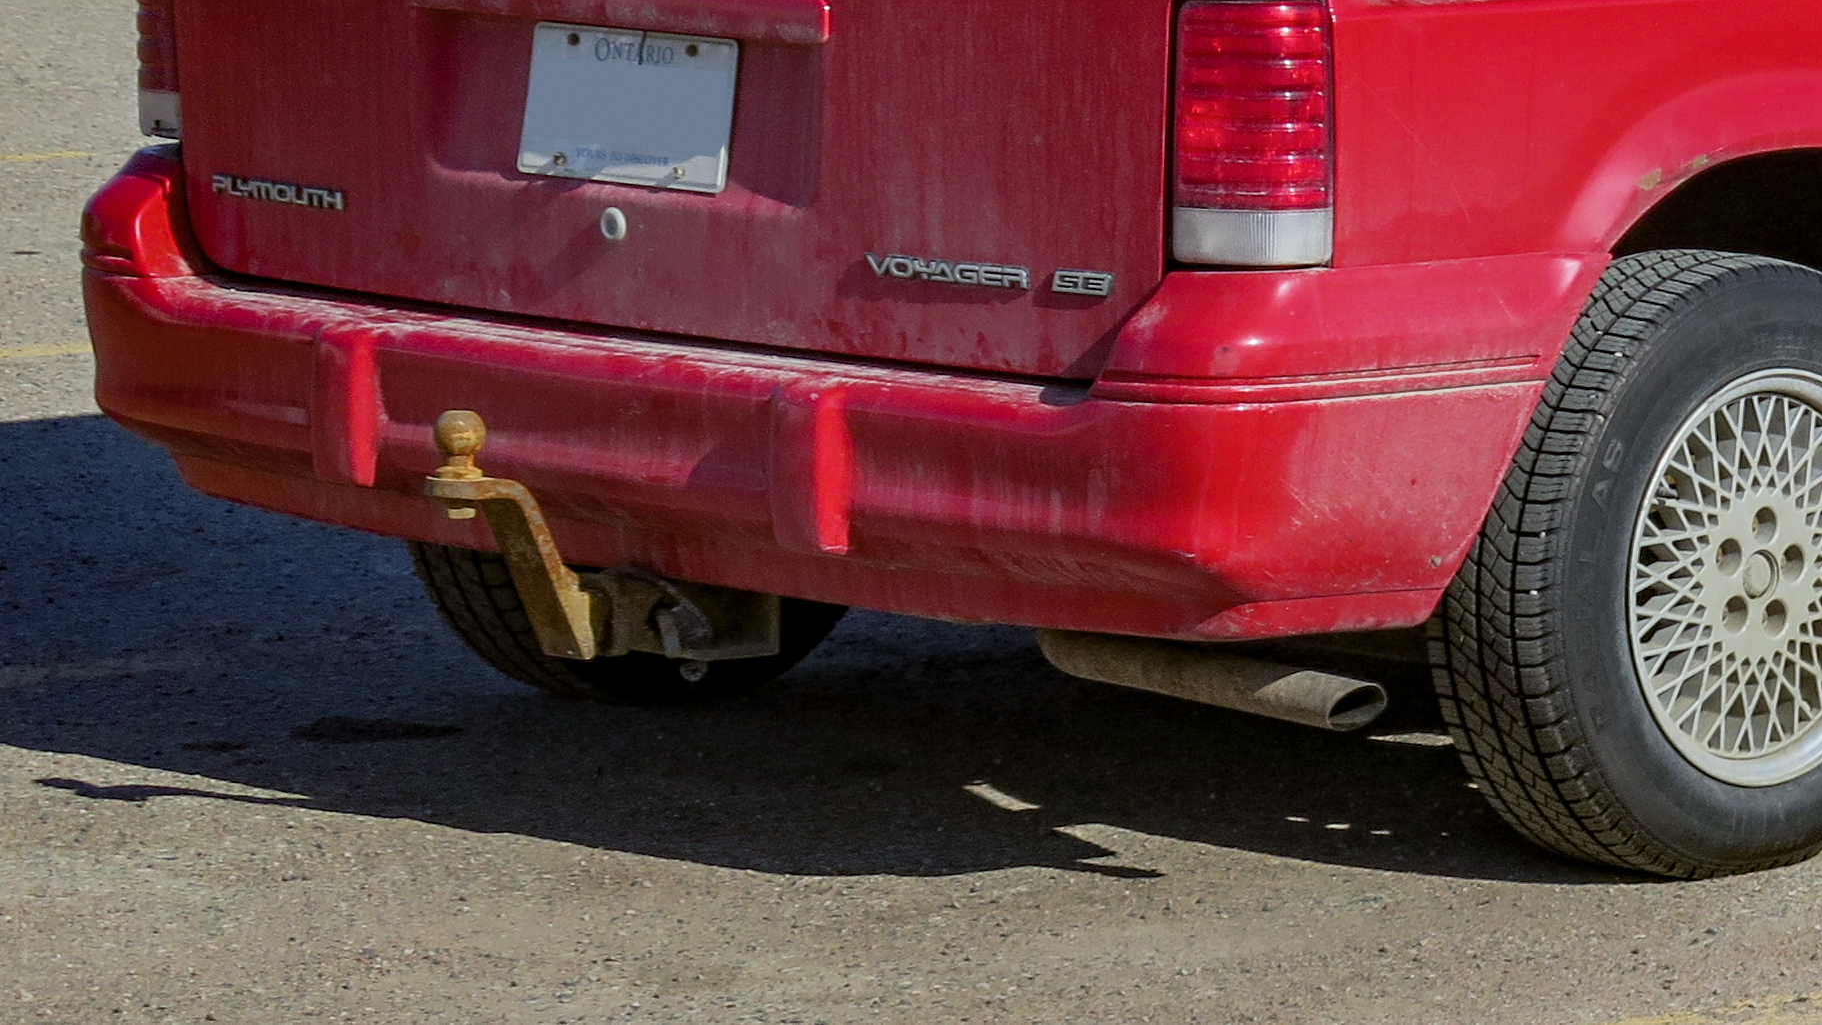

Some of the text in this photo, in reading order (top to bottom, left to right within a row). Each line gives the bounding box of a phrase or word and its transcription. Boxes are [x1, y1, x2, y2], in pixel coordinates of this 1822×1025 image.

[211, 174, 345, 211] PLYMOUTH
[865, 252, 1112, 294] VOYAGER SE
